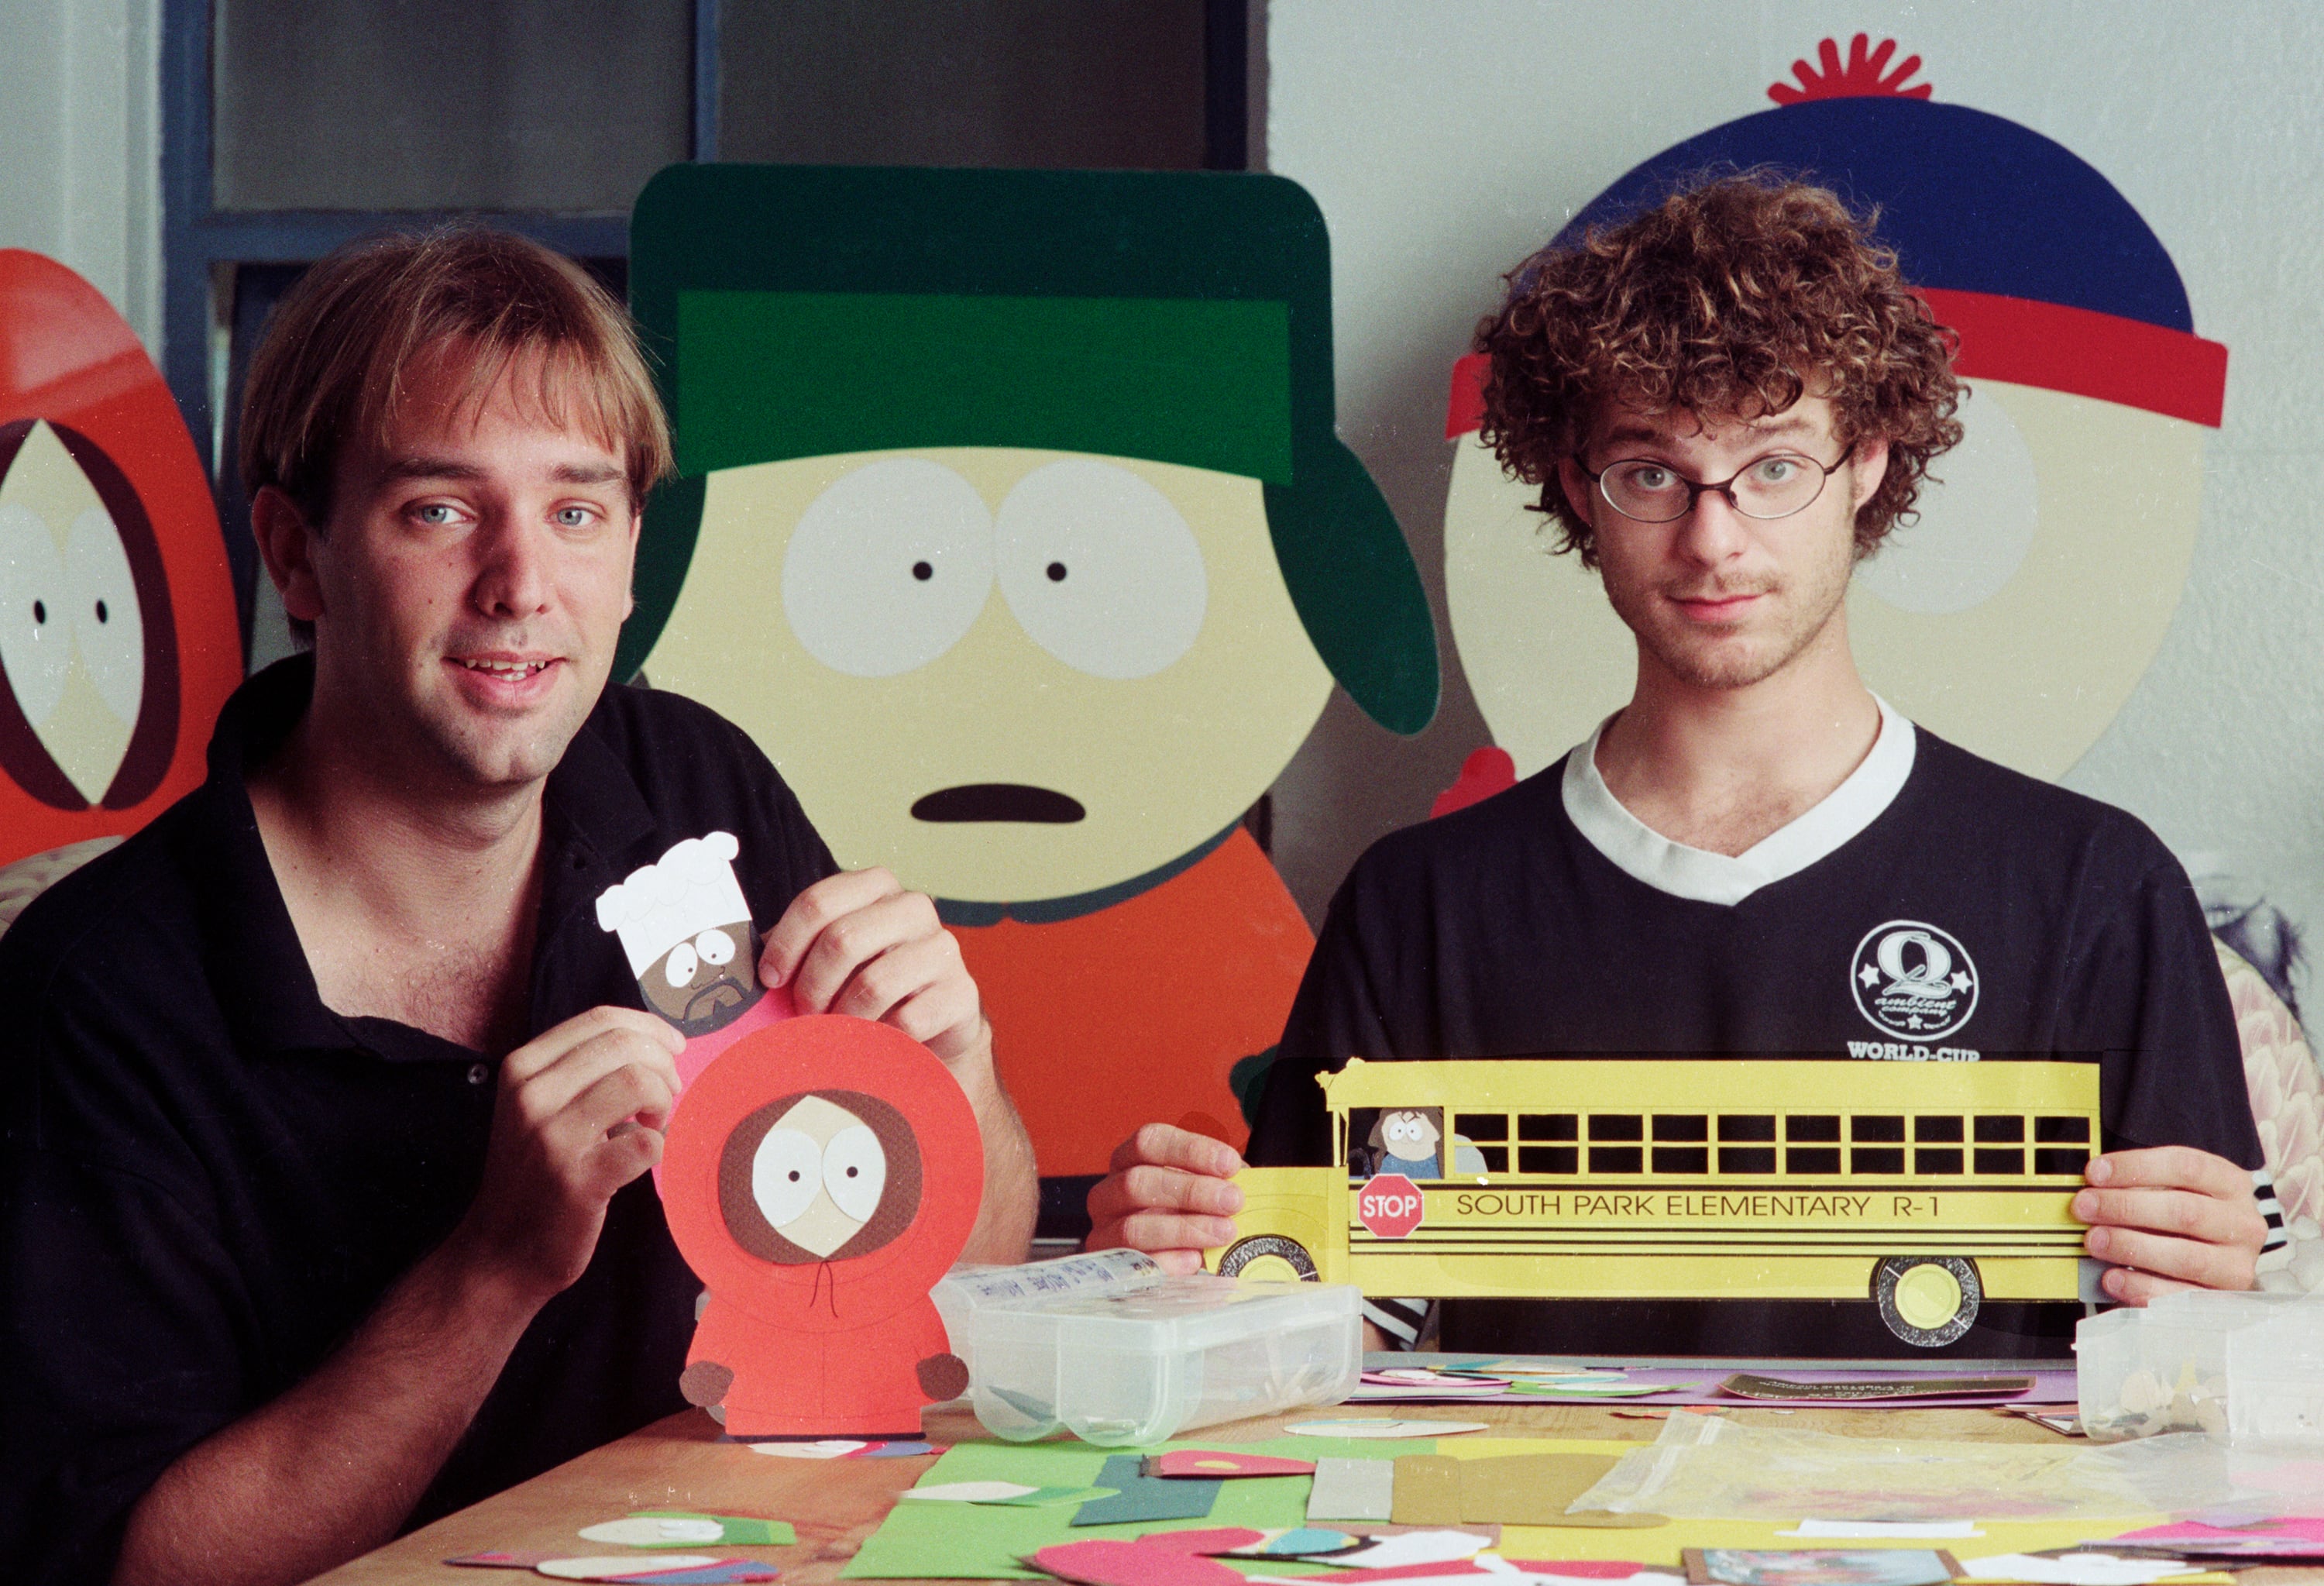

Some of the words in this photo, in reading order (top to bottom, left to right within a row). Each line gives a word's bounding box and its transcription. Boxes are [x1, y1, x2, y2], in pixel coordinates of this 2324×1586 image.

[1363, 1194, 1418, 1218] STOP
[1457, 1194, 1560, 1216] SOUTH
[1574, 1195, 1655, 1216] PARK
[1667, 1195, 1872, 1216] ELEMENTARY
[1893, 1196, 1938, 1216] R-1
